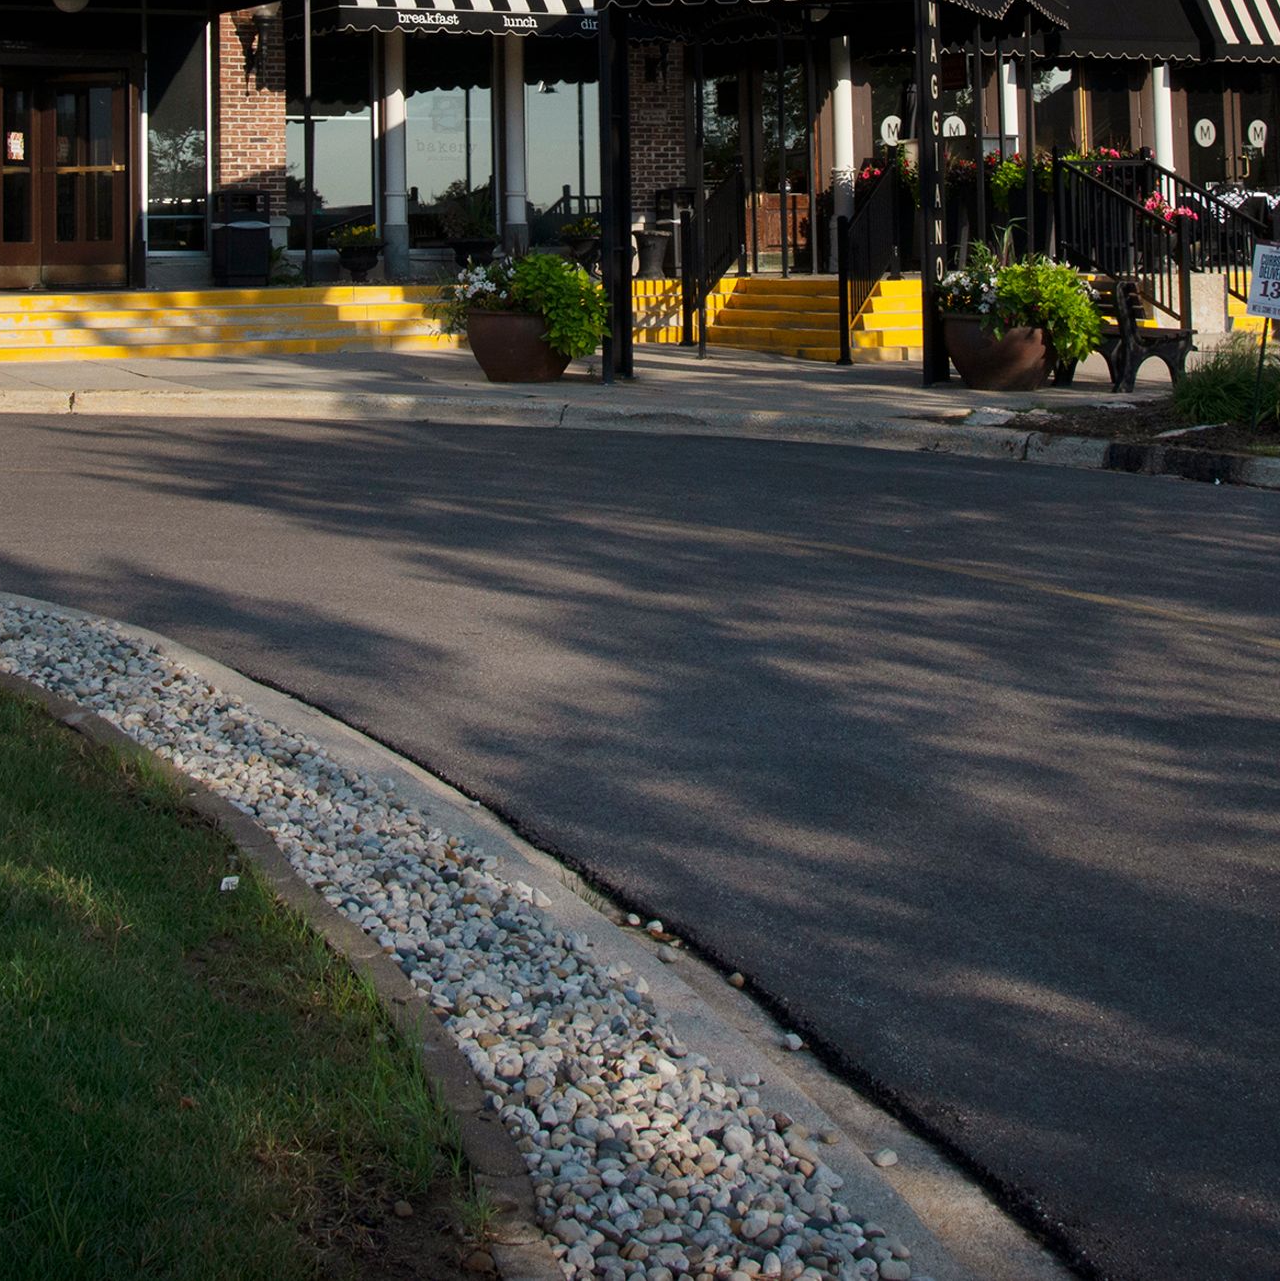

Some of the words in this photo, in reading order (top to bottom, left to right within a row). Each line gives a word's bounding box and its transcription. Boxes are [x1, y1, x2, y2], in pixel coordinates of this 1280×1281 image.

[397, 11, 460, 26] breakfast
[502, 15, 538, 28] lunch
[1200, 125, 1211, 140] M
[1253, 126, 1264, 141] M
